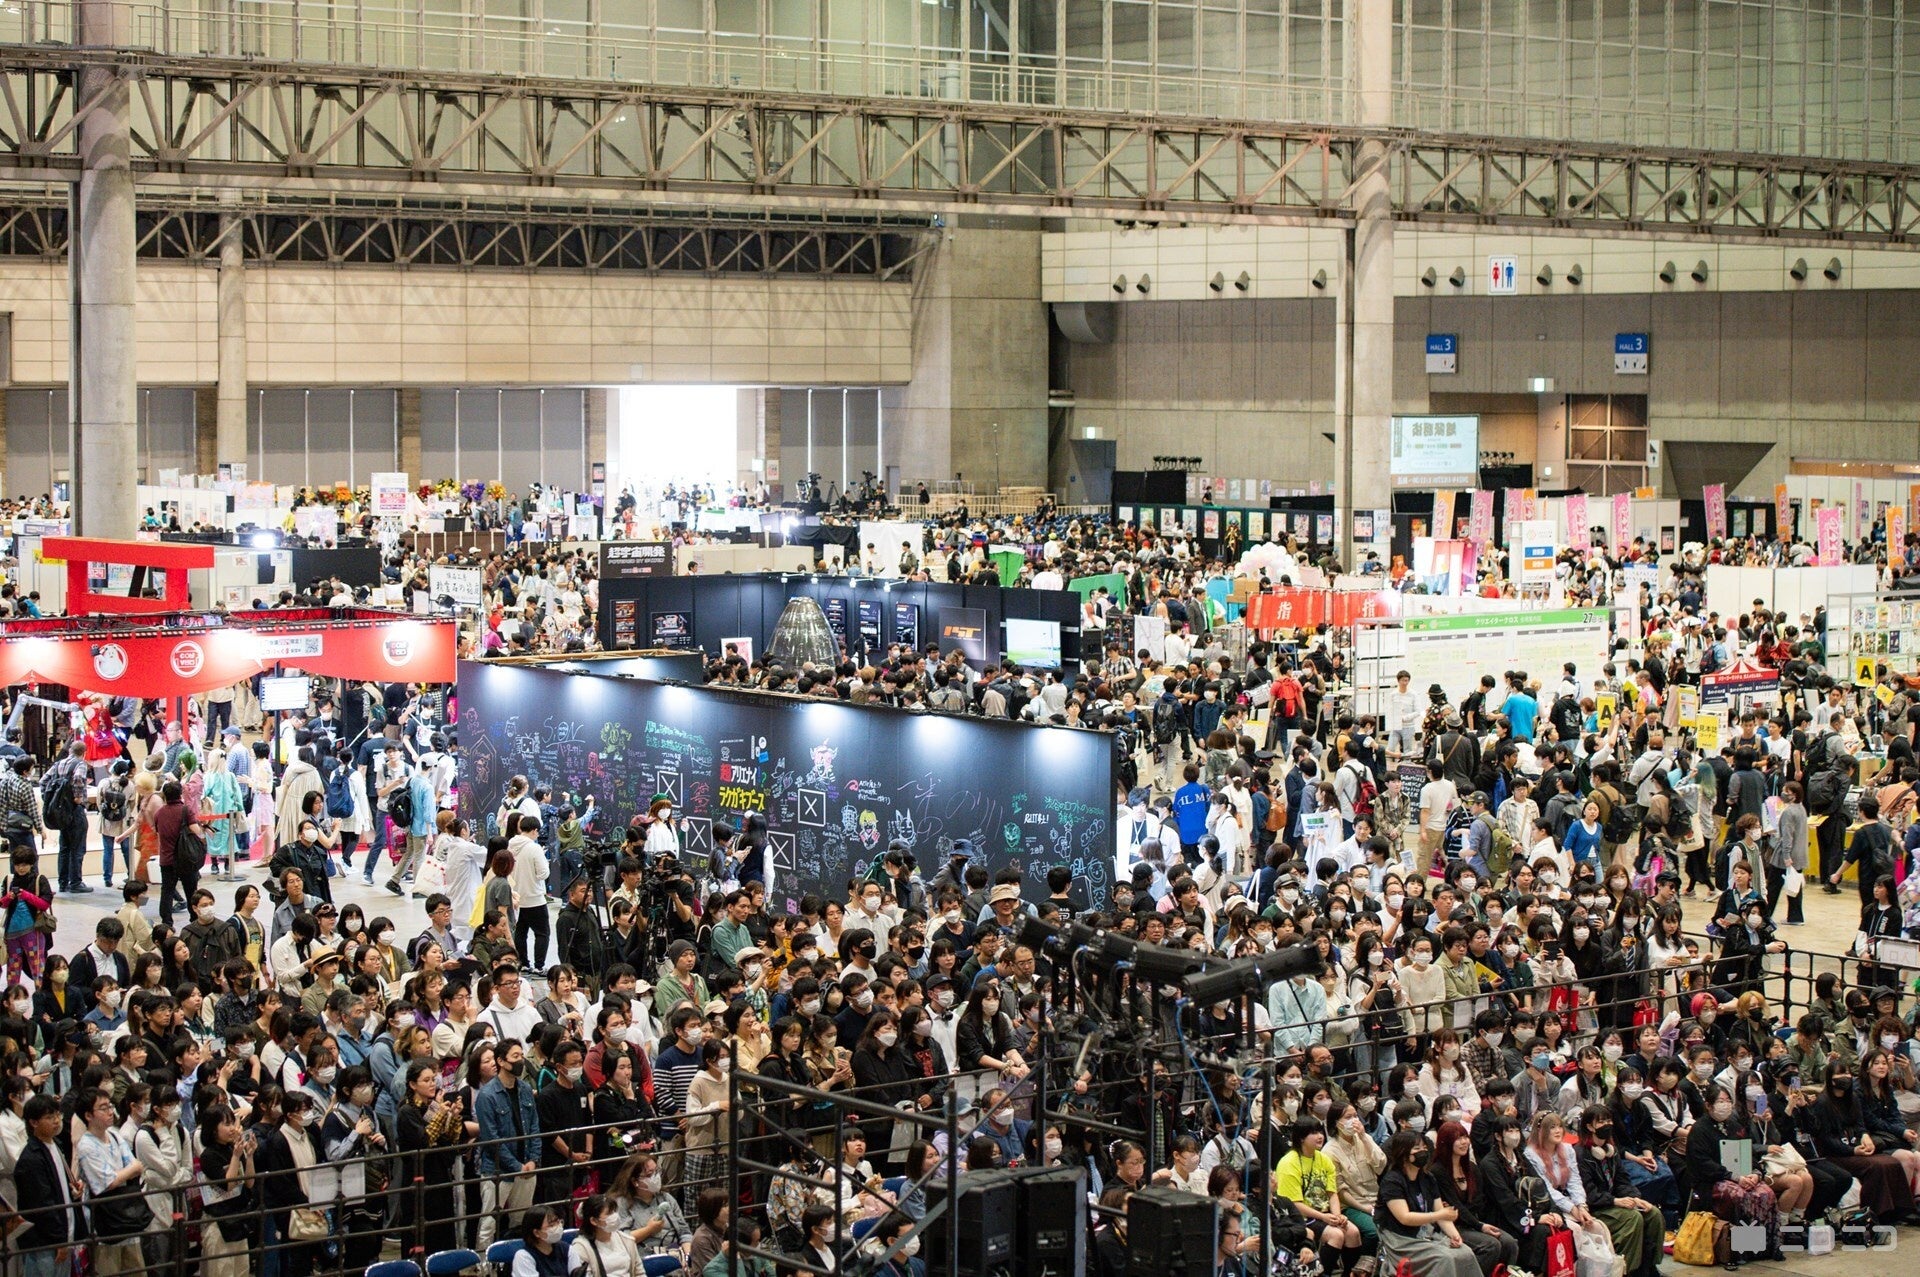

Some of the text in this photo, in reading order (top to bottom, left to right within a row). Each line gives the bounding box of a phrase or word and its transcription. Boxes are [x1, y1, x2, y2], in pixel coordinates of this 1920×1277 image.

[1444, 338, 1451, 351] 3
[1635, 338, 1643, 351] 3
[607, 546, 665, 559] 超宇宙開発
[1277, 601, 1292, 620] 指
[1362, 598, 1375, 617] 指
[1475, 616, 1518, 626] クリエイタークロス
[1859, 665, 1872, 680] A
[1600, 704, 1612, 720] A
[719, 786, 765, 812] ラクガキブース
